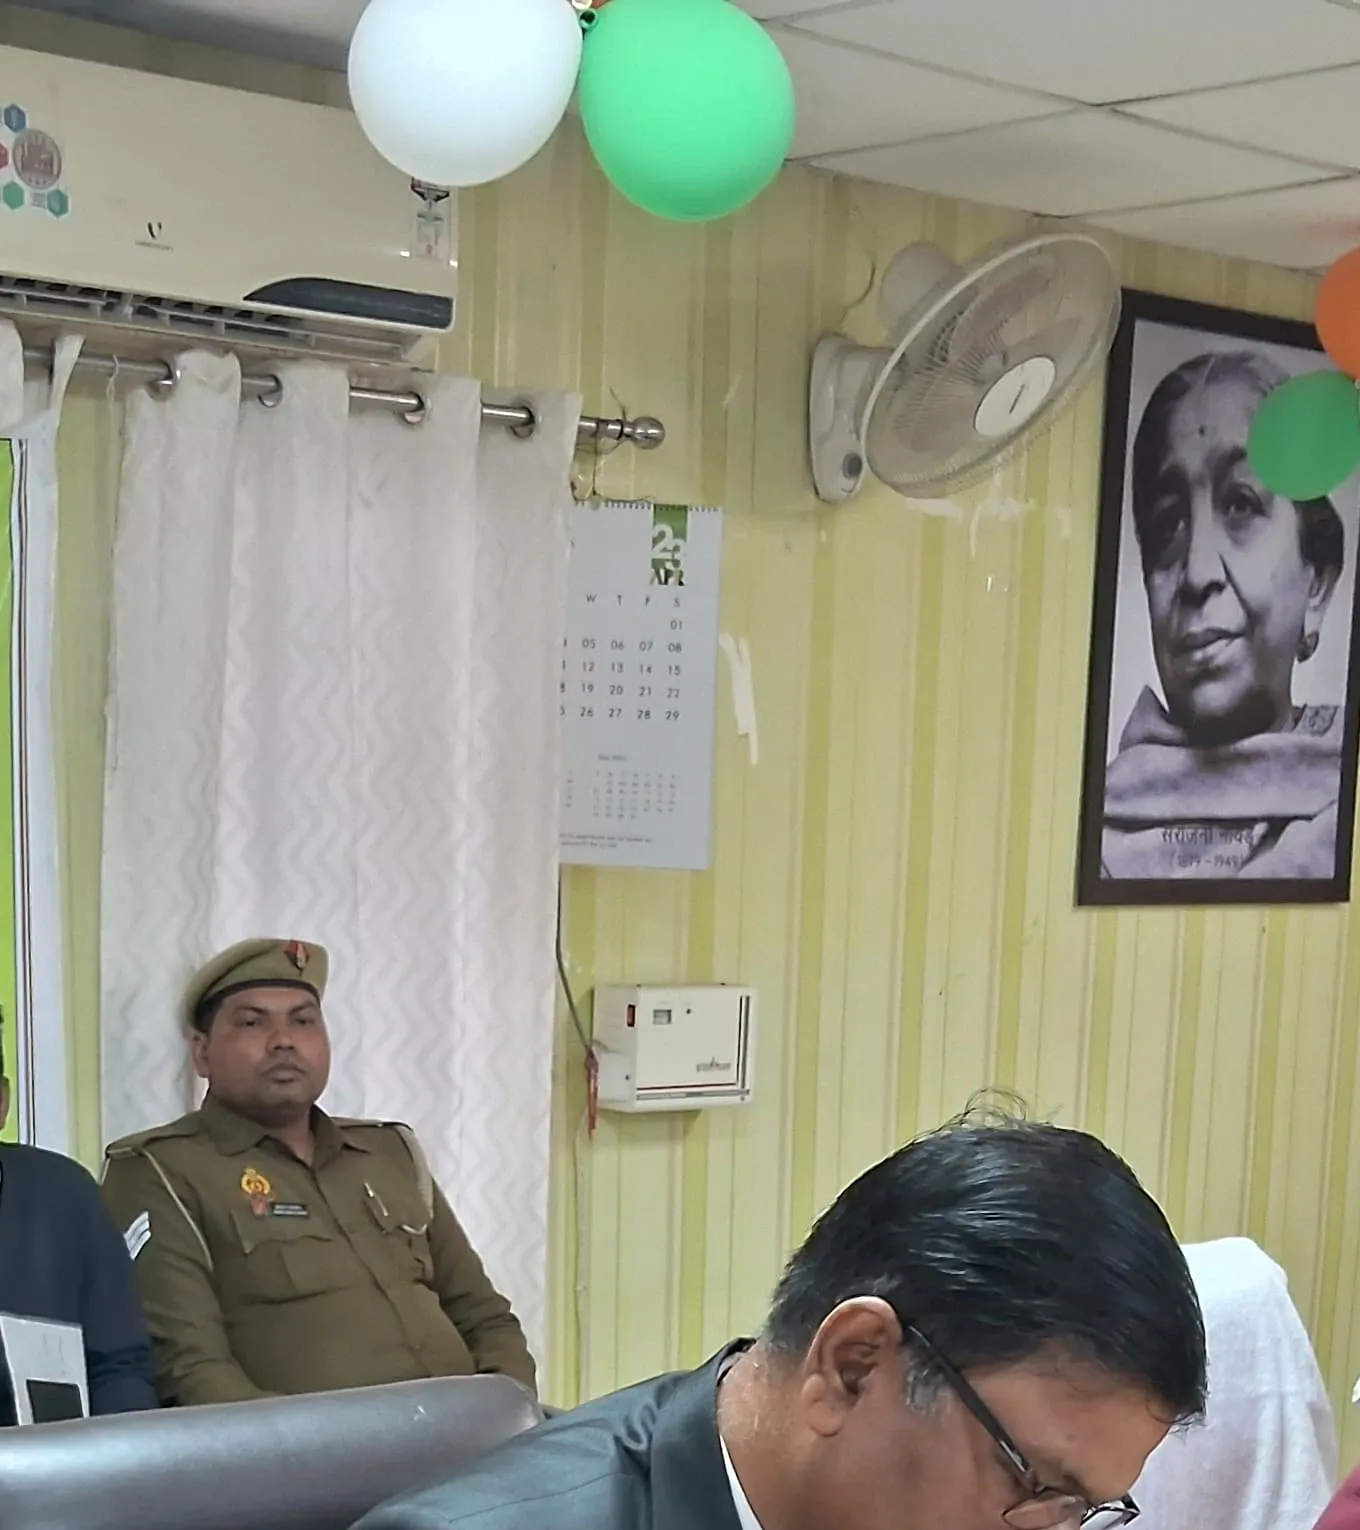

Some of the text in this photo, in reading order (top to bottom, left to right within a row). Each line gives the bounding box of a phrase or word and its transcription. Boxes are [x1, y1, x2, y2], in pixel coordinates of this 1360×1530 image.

[670, 620, 683, 630] 01
[582, 638, 682, 653] 05 06 07 08
[582, 661, 595, 672] 12
[612, 662, 623, 673] 13
[668, 664, 681, 676] 15
[582, 683, 594, 693] 19
[609, 685, 623, 696] 20
[639, 686, 652, 697] 21
[580, 706, 594, 717] 26
[609, 708, 622, 718] 27
[637, 709, 651, 719] 28
[665, 710, 680, 720] 29
